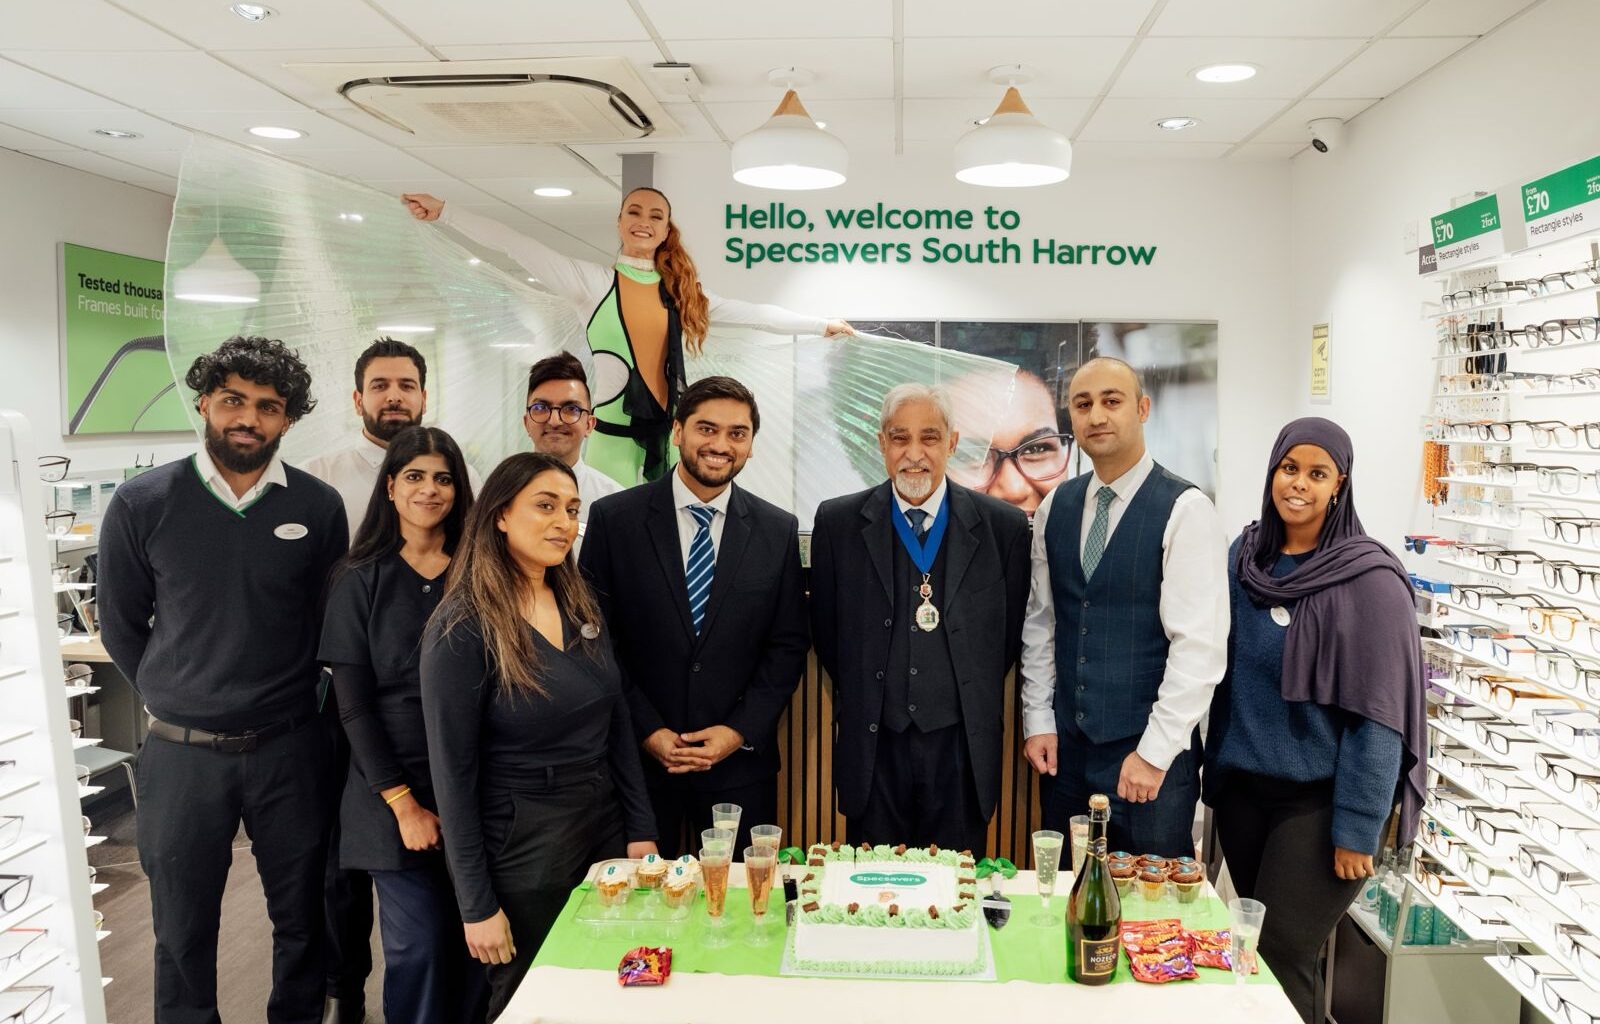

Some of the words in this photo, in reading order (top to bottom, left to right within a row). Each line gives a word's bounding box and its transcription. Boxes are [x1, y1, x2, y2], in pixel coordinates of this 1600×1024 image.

[1526, 190, 1550, 216] £70
[725, 203, 815, 232] Hello,
[826, 203, 973, 230] welcome
[984, 206, 1021, 230] to
[1530, 219, 1561, 236] Rectangle
[1562, 212, 1584, 226] styles
[1435, 222, 1454, 243] £70
[725, 237, 912, 269] Specsavers
[922, 237, 1021, 264] South
[1033, 239, 1157, 266] Harrow
[1438, 246, 1463, 260] Rectangle
[1463, 242, 1480, 254] styles
[78, 273, 121, 294] Tested
[78, 295, 122, 315] Frames
[124, 300, 149, 320] built
